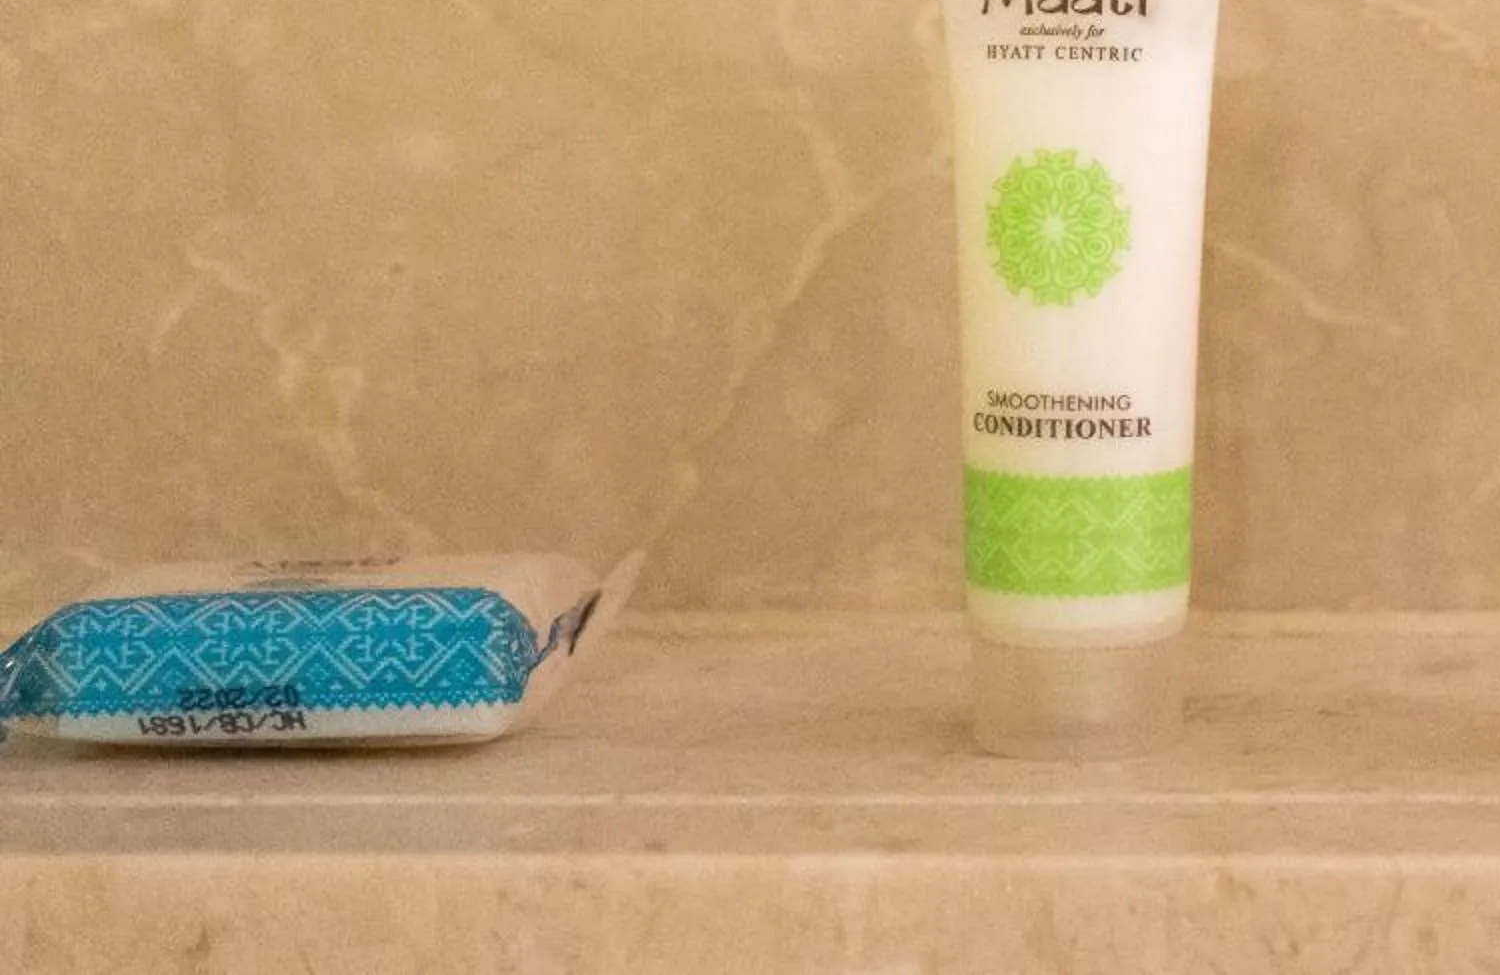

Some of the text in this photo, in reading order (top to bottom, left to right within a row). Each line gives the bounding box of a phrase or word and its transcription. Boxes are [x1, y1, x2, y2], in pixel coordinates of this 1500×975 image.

[1019, 24, 1105, 39] exclusively for
[986, 45, 1144, 62] HYATT CENTRIC
[987, 389, 1132, 412] SMOOTHENING
[973, 412, 1152, 439] CONDITIONER
[177, 685, 299, 711] 02/2022
